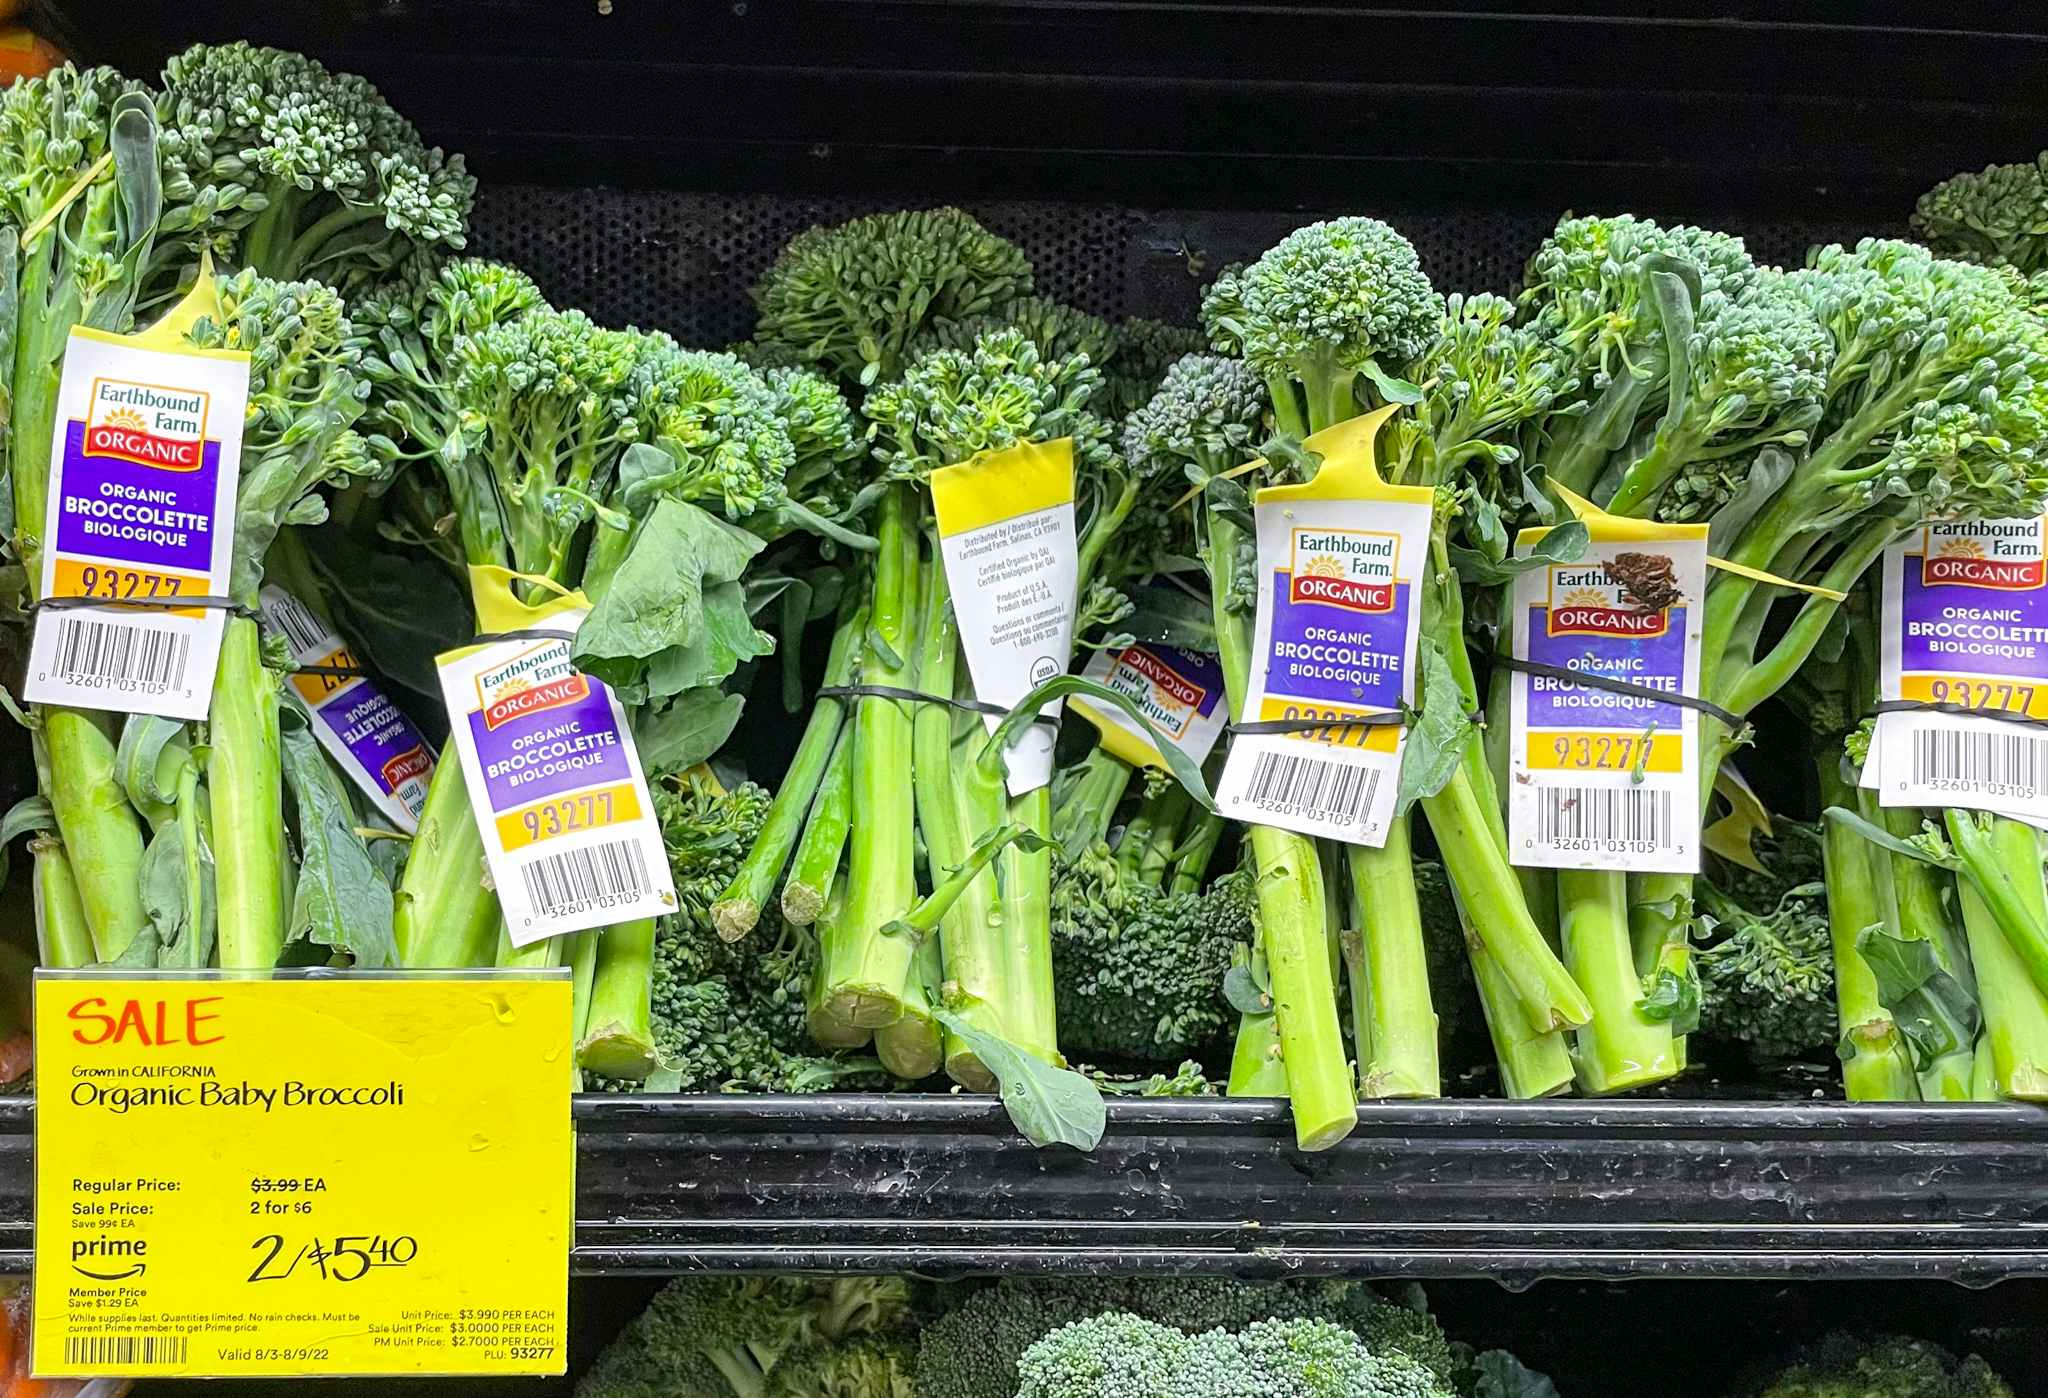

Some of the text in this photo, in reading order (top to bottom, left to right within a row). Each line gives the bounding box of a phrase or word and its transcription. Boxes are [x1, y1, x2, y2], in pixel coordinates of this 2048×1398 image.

[100, 384, 201, 413] Earthbound
[95, 431, 191, 463] ORGANIC
[100, 482, 177, 506] ORGANIC
[65, 496, 209, 532] BROCCOLETTE
[84, 520, 188, 547] BIOLOGIQUE
[1933, 520, 2038, 537] Earthbound
[1300, 535, 1393, 557] Earthbound
[1933, 562, 2034, 582] ORGANIC
[83, 567, 181, 601] 93277
[1300, 580, 1385, 605] ORGANIC
[1559, 611, 1657, 629] ORGANIC
[1942, 607, 2023, 622] ORGANIC
[1305, 627, 1372, 646] ORGANIC
[1275, 641, 1399, 671] BROCCOLETTE
[1930, 640, 2036, 659] BIOLOGIQUE
[482, 641, 568, 689] Earthbound
[1567, 658, 1643, 670] ORGANIC
[1128, 652, 1196, 701] ORGANIC
[1289, 664, 1381, 685] BIOLOGIQUE
[38, 672, 192, 699] 0 32601 03105 3
[492, 681, 578, 720] ORGANIC
[1553, 696, 1656, 710] BIOLOGIQUE
[511, 721, 581, 750] ORGANIC
[487, 731, 616, 779] BROCCOLETTE
[510, 752, 603, 787] BIOLOGIQUE
[1900, 779, 2034, 799] 0 32601 03105
[523, 792, 613, 840] 93277
[1233, 796, 1378, 832] 0 32601 03105 3
[1526, 839, 1684, 854] 0 32601 03105 3
[524, 889, 664, 927] 0 32601 03105 3
[67, 996, 226, 1046] SALE
[72, 1064, 216, 1078] Grown in CALIFORNIA
[71, 1080, 404, 1114] Organic Baby Broccoli
[72, 1177, 327, 1194] Regular Price: $3.99 EA
[72, 1200, 312, 1215] Sale Price: 2 for $6
[72, 1219, 136, 1228] Save 99¢ EA
[72, 1234, 147, 1262] prime
[69, 1288, 147, 1297] Member Price
[69, 1299, 139, 1308] Save $1.29 EA
[69, 1313, 96, 1323] While
[99, 1313, 137, 1325] supplies
[161, 1313, 208, 1323] Quantities
[250, 1313, 263, 1322] No
[266, 1312, 283, 1322] rain
[322, 1313, 346, 1322] Must
[349, 1312, 360, 1322] be
[402, 1309, 555, 1321] Unit Price: $3.990 PER EACH
[68, 1324, 102, 1333] current
[105, 1324, 132, 1333] Prime
[134, 1324, 172, 1332] member
[176, 1324, 185, 1332] to
[188, 1325, 202, 1334] get
[205, 1324, 232, 1332] Prime
[368, 1323, 555, 1334] Sale Unit Price: $3.0000 PER EACH
[374, 1336, 555, 1348] PM Unit Price: $2.7000 PER EACH
[218, 1348, 329, 1361] Valid 8/3-8/9/22
[484, 1347, 555, 1360] PLU: 93277
